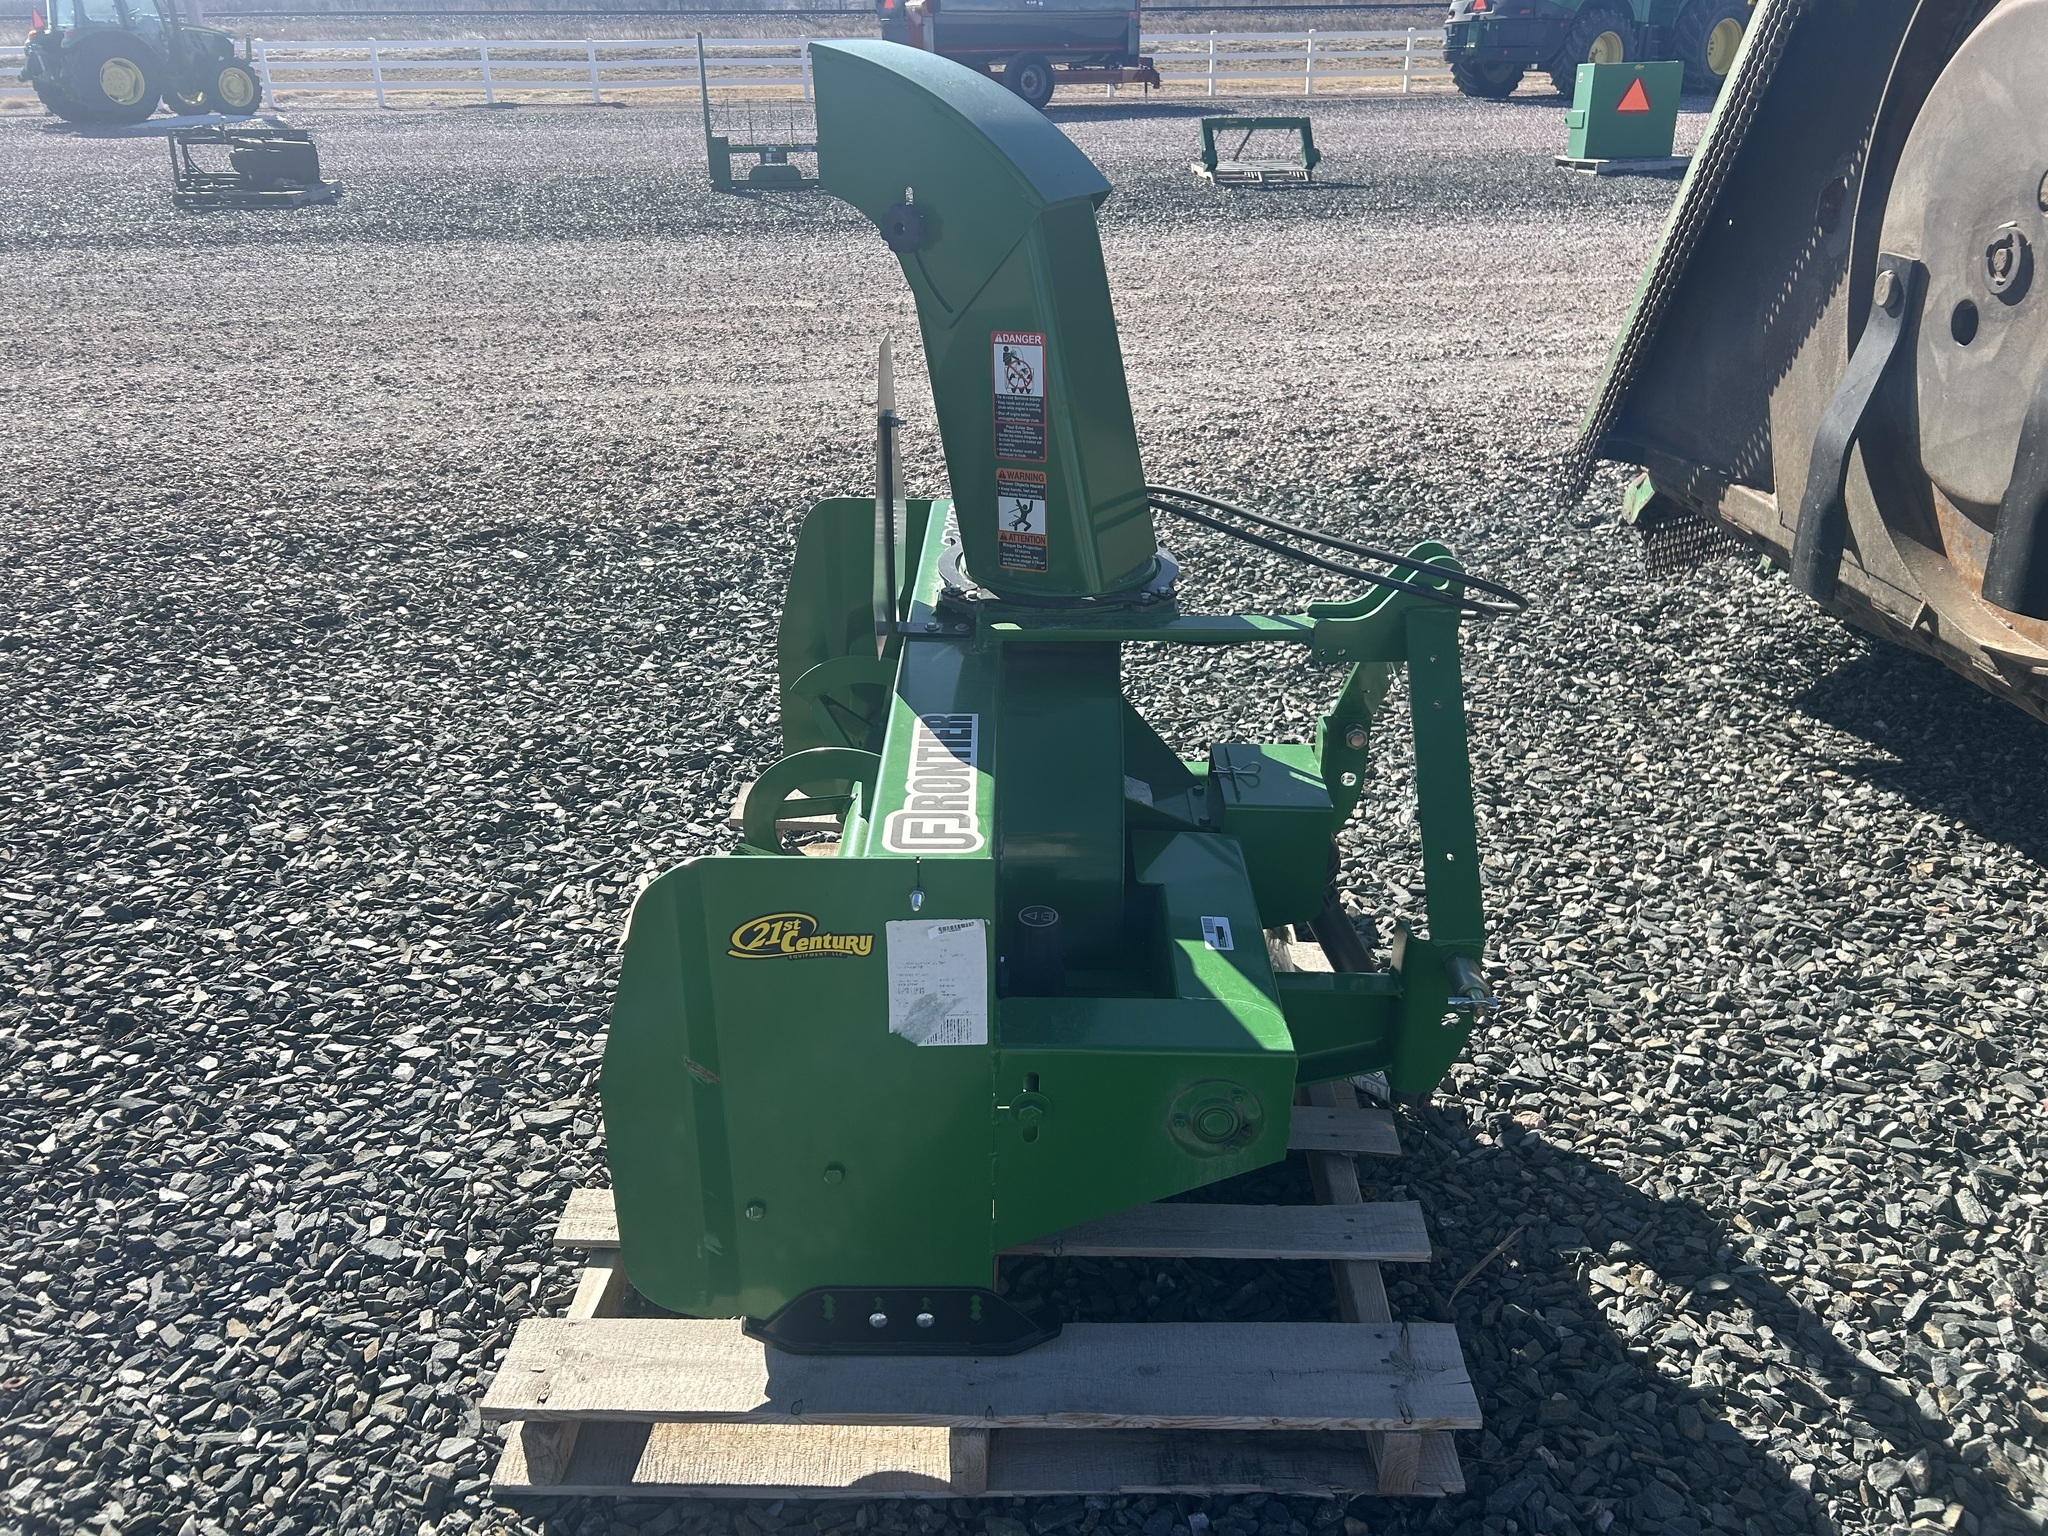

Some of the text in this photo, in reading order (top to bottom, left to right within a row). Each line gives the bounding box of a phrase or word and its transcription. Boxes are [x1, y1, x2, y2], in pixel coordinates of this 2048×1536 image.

[1002, 333, 1042, 345] DANGER
[1007, 471, 1044, 482] WARNING
[1008, 533, 1046, 545] ATTENTION
[890, 715, 978, 849] FRONTIER
[745, 918, 802, 950] 21st
[788, 952, 828, 960] EQUIPMENT
